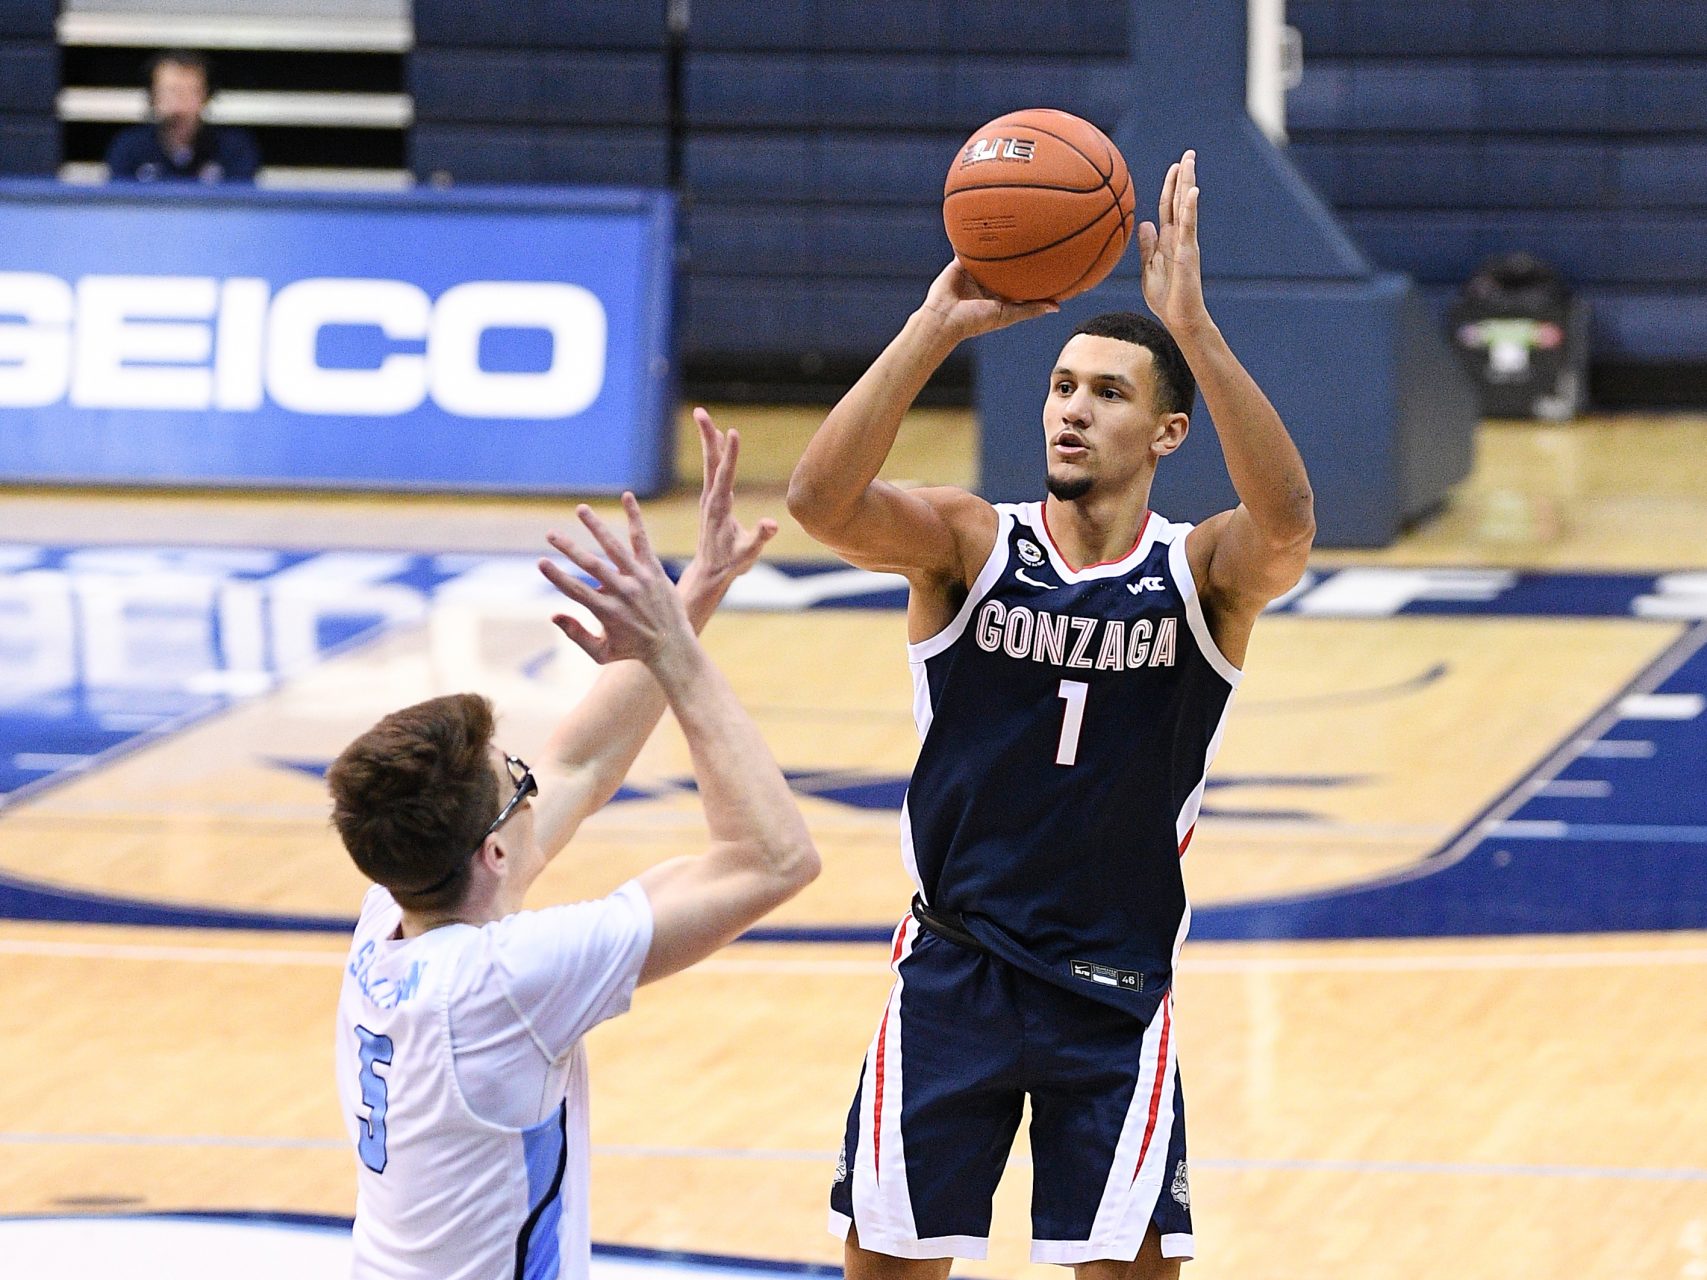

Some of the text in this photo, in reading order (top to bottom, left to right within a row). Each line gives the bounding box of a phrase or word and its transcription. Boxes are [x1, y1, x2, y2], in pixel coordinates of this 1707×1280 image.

[1126, 576, 1166, 595] WCC
[975, 599, 1178, 671] GONZAGA
[1055, 679, 1089, 766] 1
[1121, 975, 1135, 985] 46
[353, 1023, 393, 1175] 5
